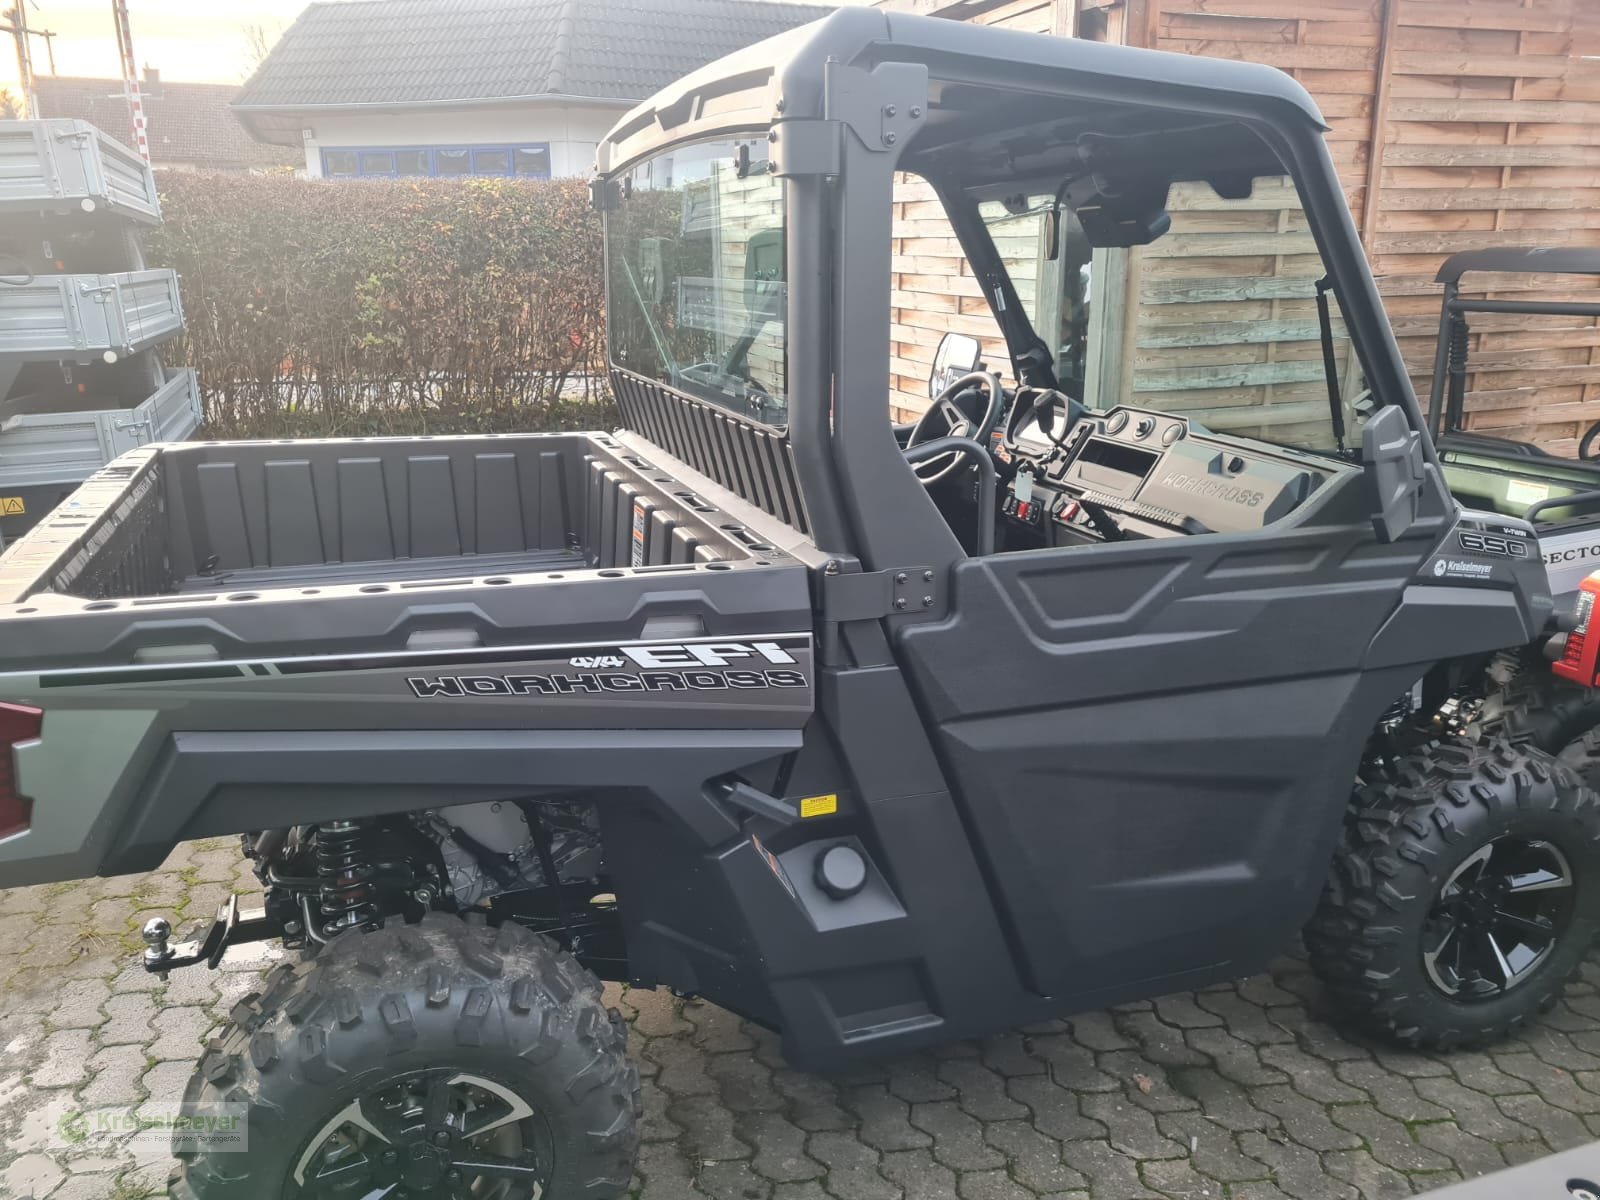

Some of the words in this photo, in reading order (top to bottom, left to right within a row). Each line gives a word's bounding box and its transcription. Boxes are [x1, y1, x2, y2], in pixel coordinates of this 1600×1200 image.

[1160, 471, 1264, 507] WORKCROSS
[1459, 531, 1529, 558] 650
[1503, 527, 1527, 537] V-TWIN
[1447, 560, 1493, 575] Kreiselmeyer
[619, 642, 798, 669] EFI
[405, 670, 809, 698] WORKCROSS
